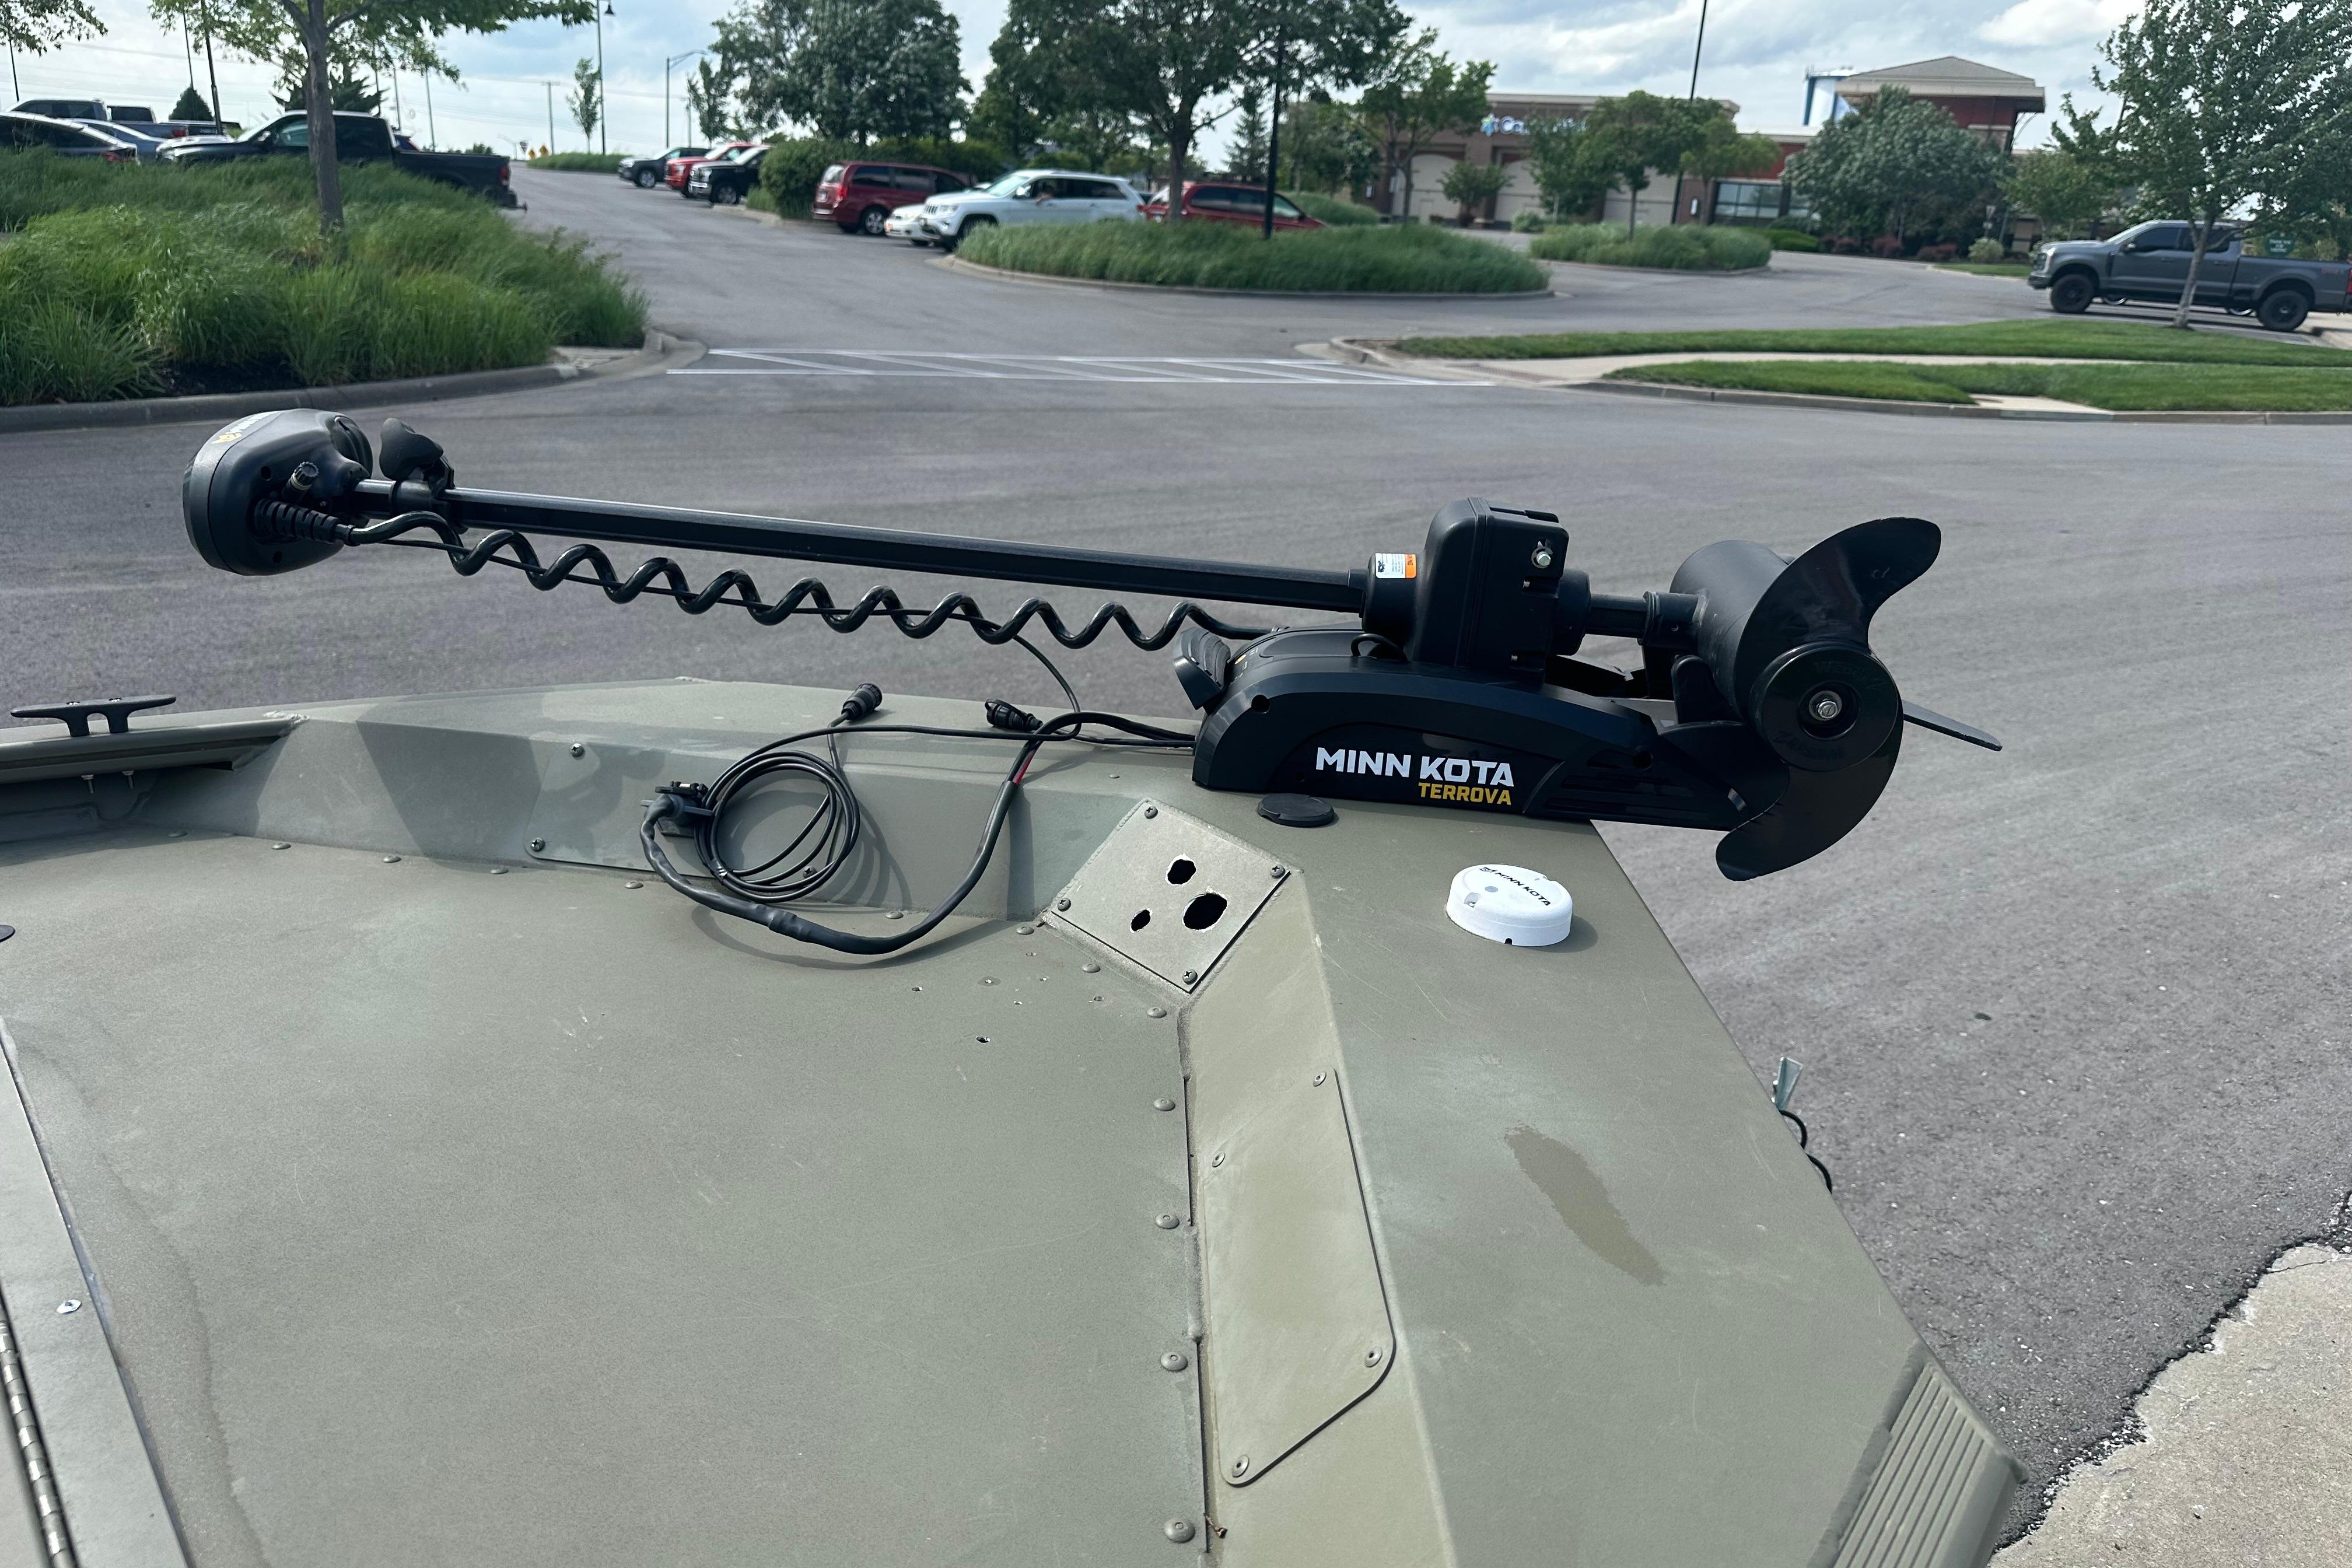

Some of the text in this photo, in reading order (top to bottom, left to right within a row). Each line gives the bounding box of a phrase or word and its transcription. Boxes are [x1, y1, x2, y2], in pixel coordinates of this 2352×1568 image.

[1316, 747, 1514, 787] MINN KOTA
[1418, 782, 1511, 805] TERROVA
[1494, 872, 1551, 906] MINN KOTA
